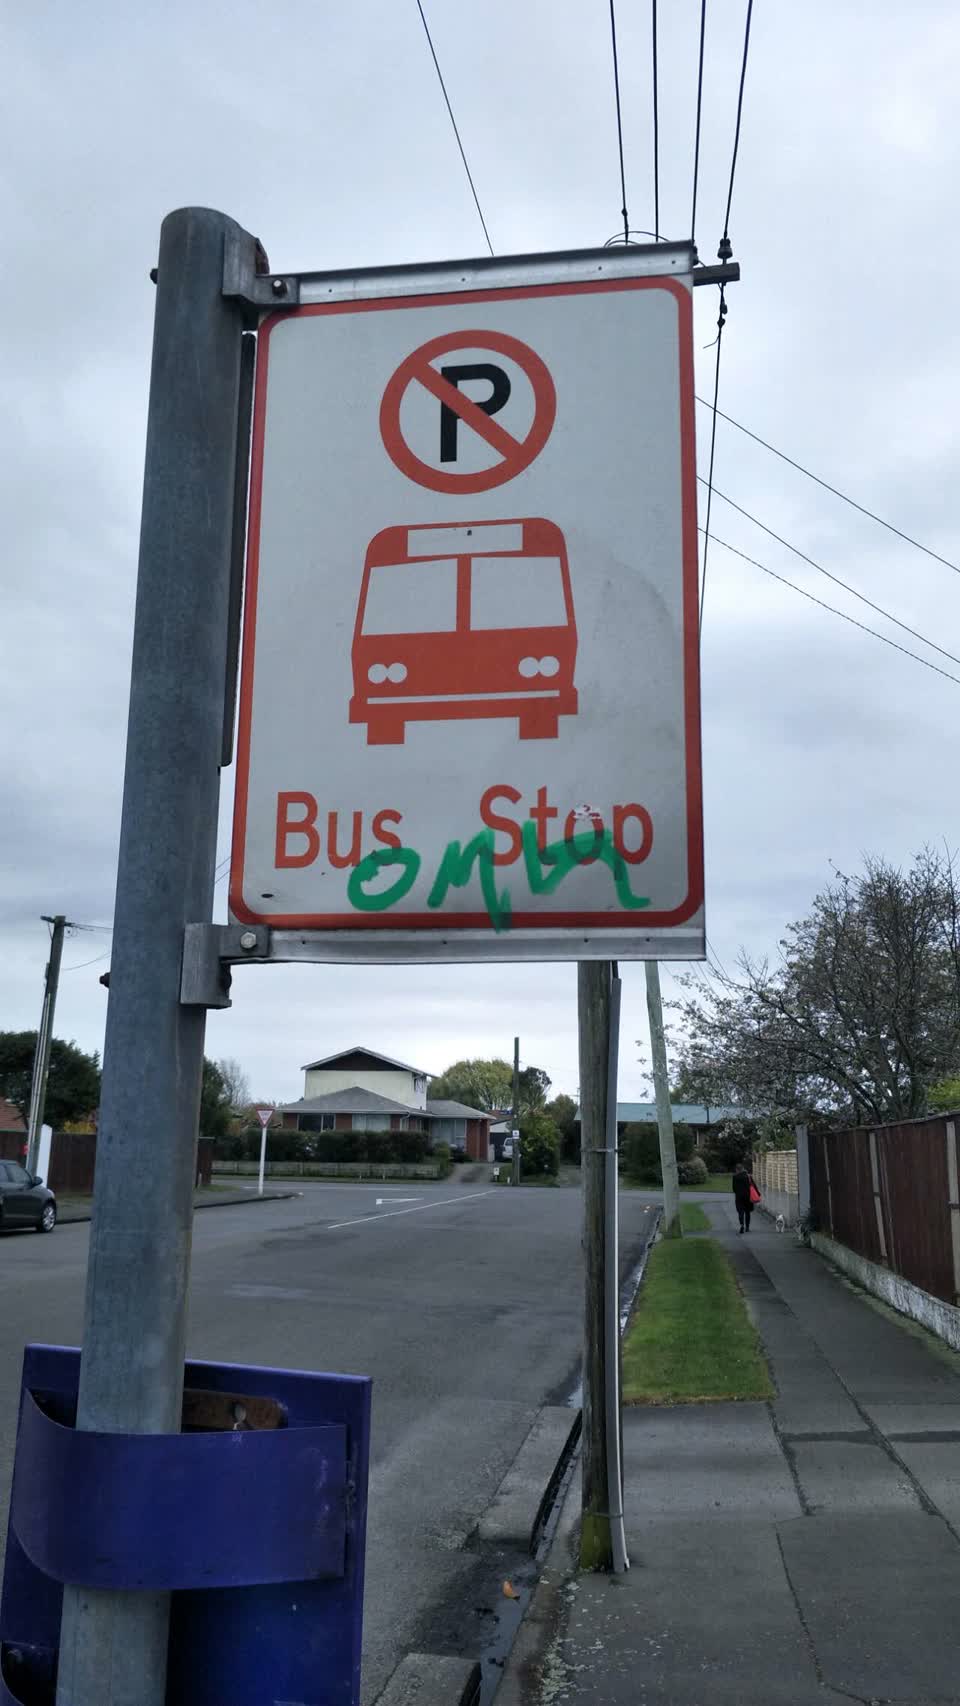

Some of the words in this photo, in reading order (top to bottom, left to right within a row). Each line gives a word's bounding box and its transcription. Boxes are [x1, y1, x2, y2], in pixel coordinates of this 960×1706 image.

[440, 364, 511, 462] P
[275, 791, 402, 867] Bus
[480, 784, 654, 880] Stop
